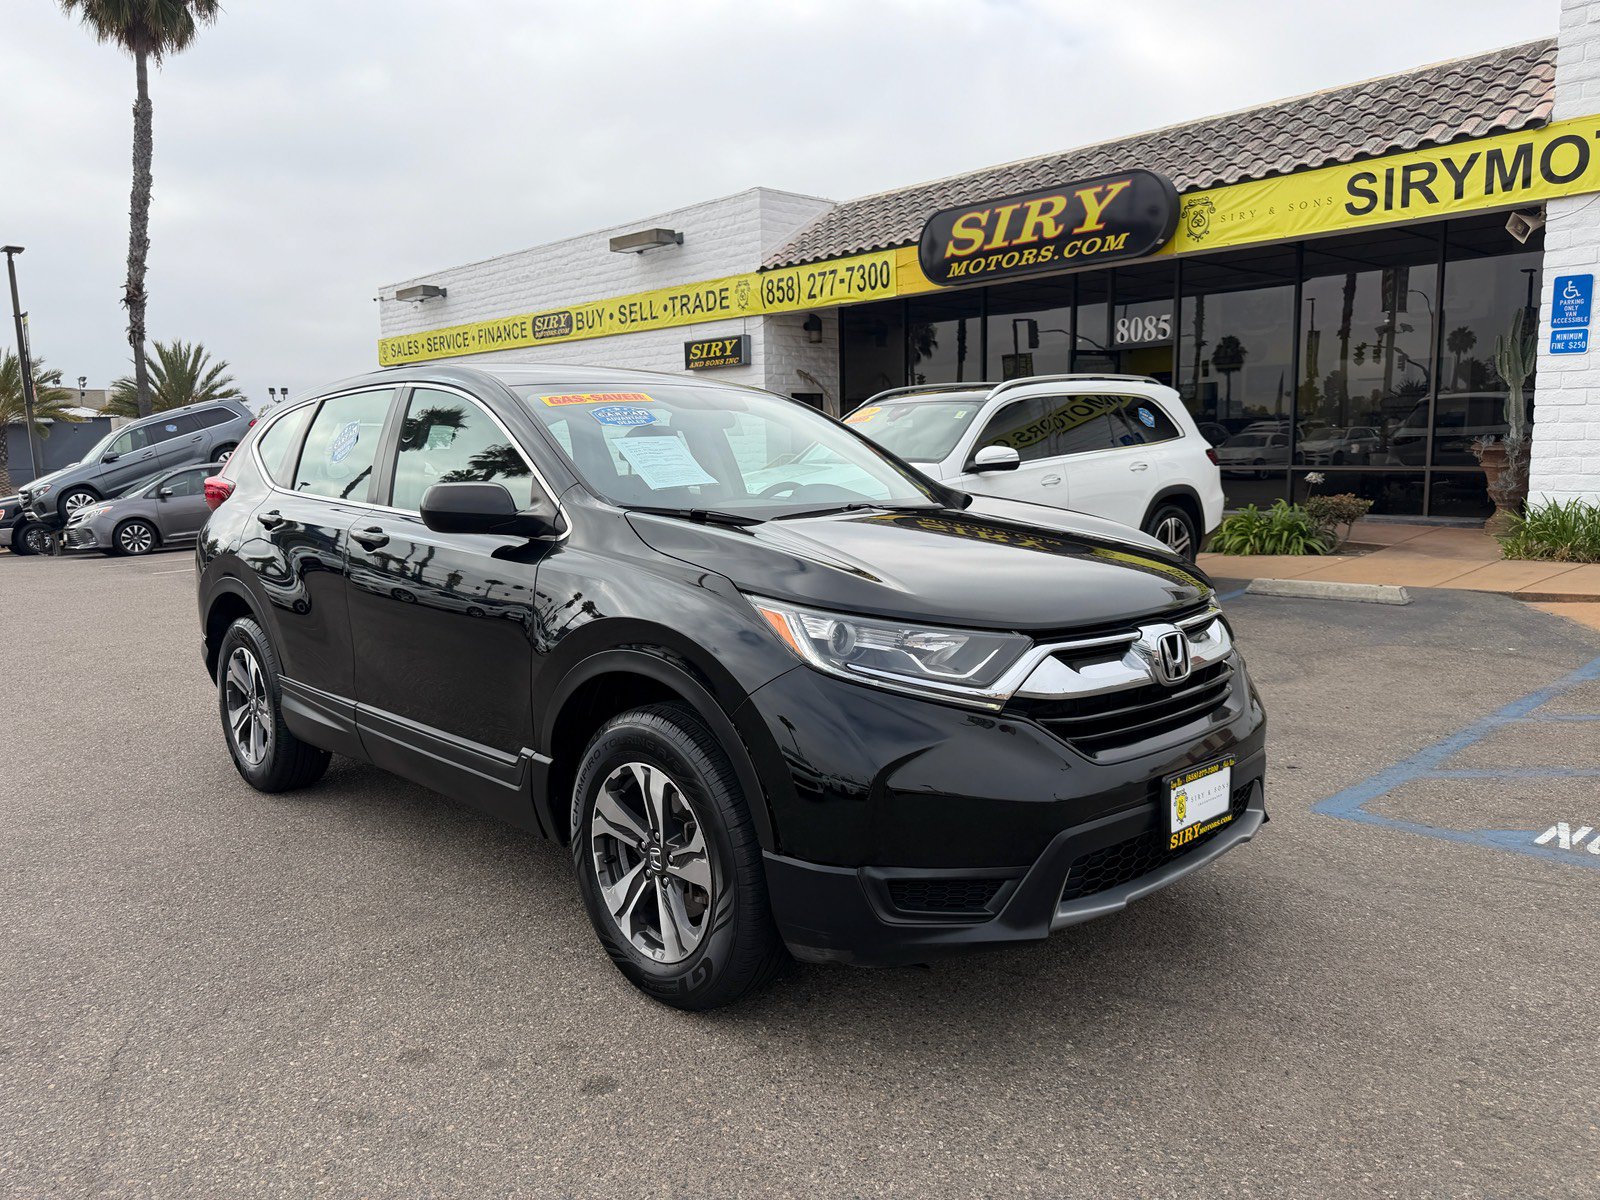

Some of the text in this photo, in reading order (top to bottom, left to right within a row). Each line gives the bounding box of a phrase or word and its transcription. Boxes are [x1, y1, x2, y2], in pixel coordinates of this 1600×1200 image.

[1344, 130, 1600, 216] SIRYMO
[944, 178, 1133, 259] SIRY
[1220, 196, 1333, 223] SIRY & SONS
[946, 232, 1130, 278] MOTORS.COM
[760, 260, 890, 309] (858) 277-7300
[575, 287, 730, 331] BUY SELL TRADE
[1559, 298, 1585, 306] PARKING
[535, 313, 570, 331] SIRY
[1116, 314, 1172, 344] 8085
[1553, 316, 1588, 324] ACCESSIBLE
[390, 321, 528, 358] SALES SERVICE FINANCE
[689, 338, 738, 360] SIRY
[1551, 341, 1586, 350] FINE $250
[1556, 332, 1583, 340] MINIMUM
[688, 357, 740, 368] AND SONS INC
[1169, 822, 1202, 850] SIRY
